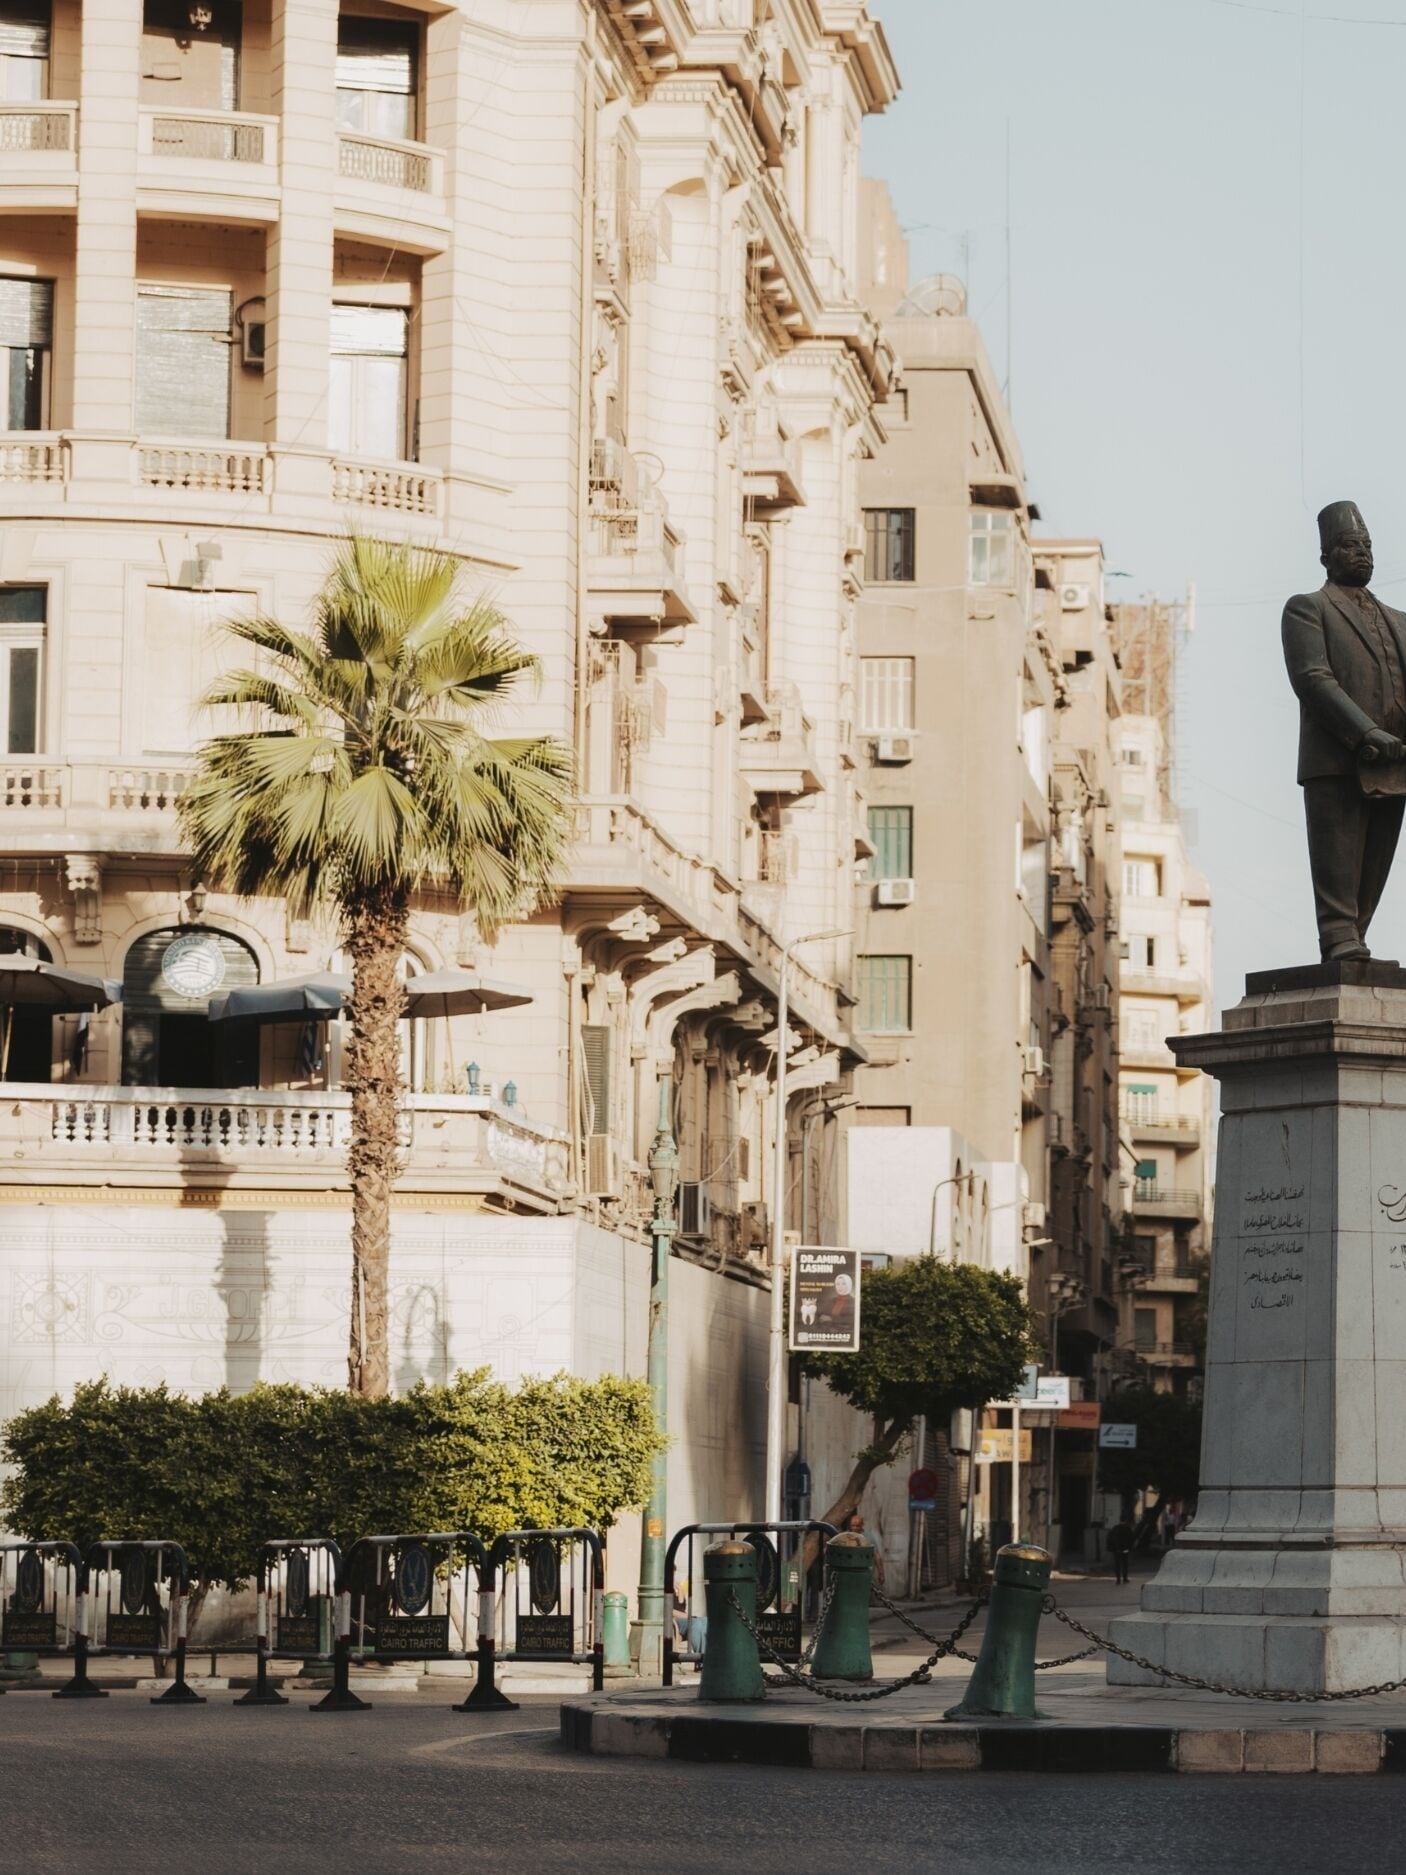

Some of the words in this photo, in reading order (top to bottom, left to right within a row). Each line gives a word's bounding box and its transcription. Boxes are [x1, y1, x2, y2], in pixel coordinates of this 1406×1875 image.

[800, 1263, 833, 1274] LASHIN
[380, 1638, 407, 1649] CAIRO
[408, 1638, 443, 1649] TRAFFIC
[543, 1636, 570, 1649] TRAFFIC
[765, 1636, 795, 1649] AFFIC
